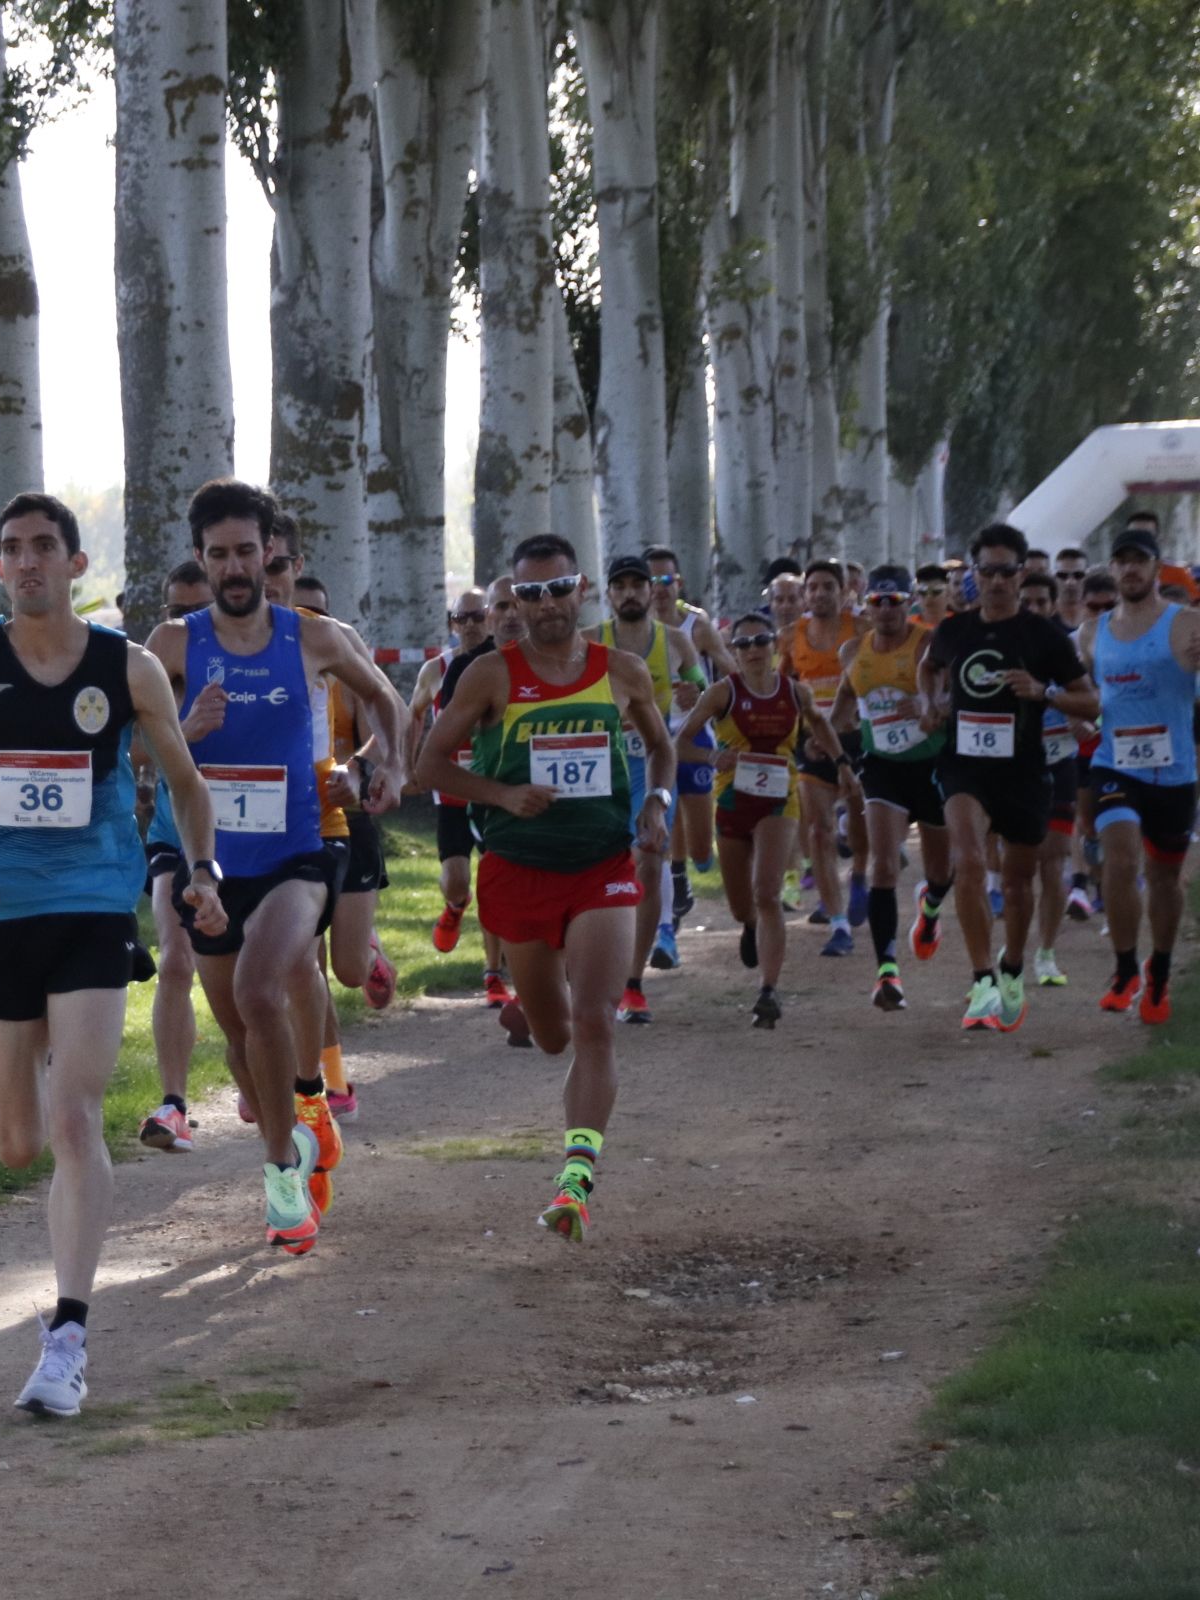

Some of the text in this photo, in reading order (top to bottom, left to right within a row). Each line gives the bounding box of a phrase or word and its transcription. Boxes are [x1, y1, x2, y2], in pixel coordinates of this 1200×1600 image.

[228, 691, 257, 704] Caja
[887, 727, 909, 746] 61
[972, 732, 996, 748] 16
[1128, 744, 1154, 760] 45
[546, 761, 598, 785] 187
[755, 772, 769, 788] 2
[19, 783, 64, 812] 36
[234, 794, 246, 818] 1
